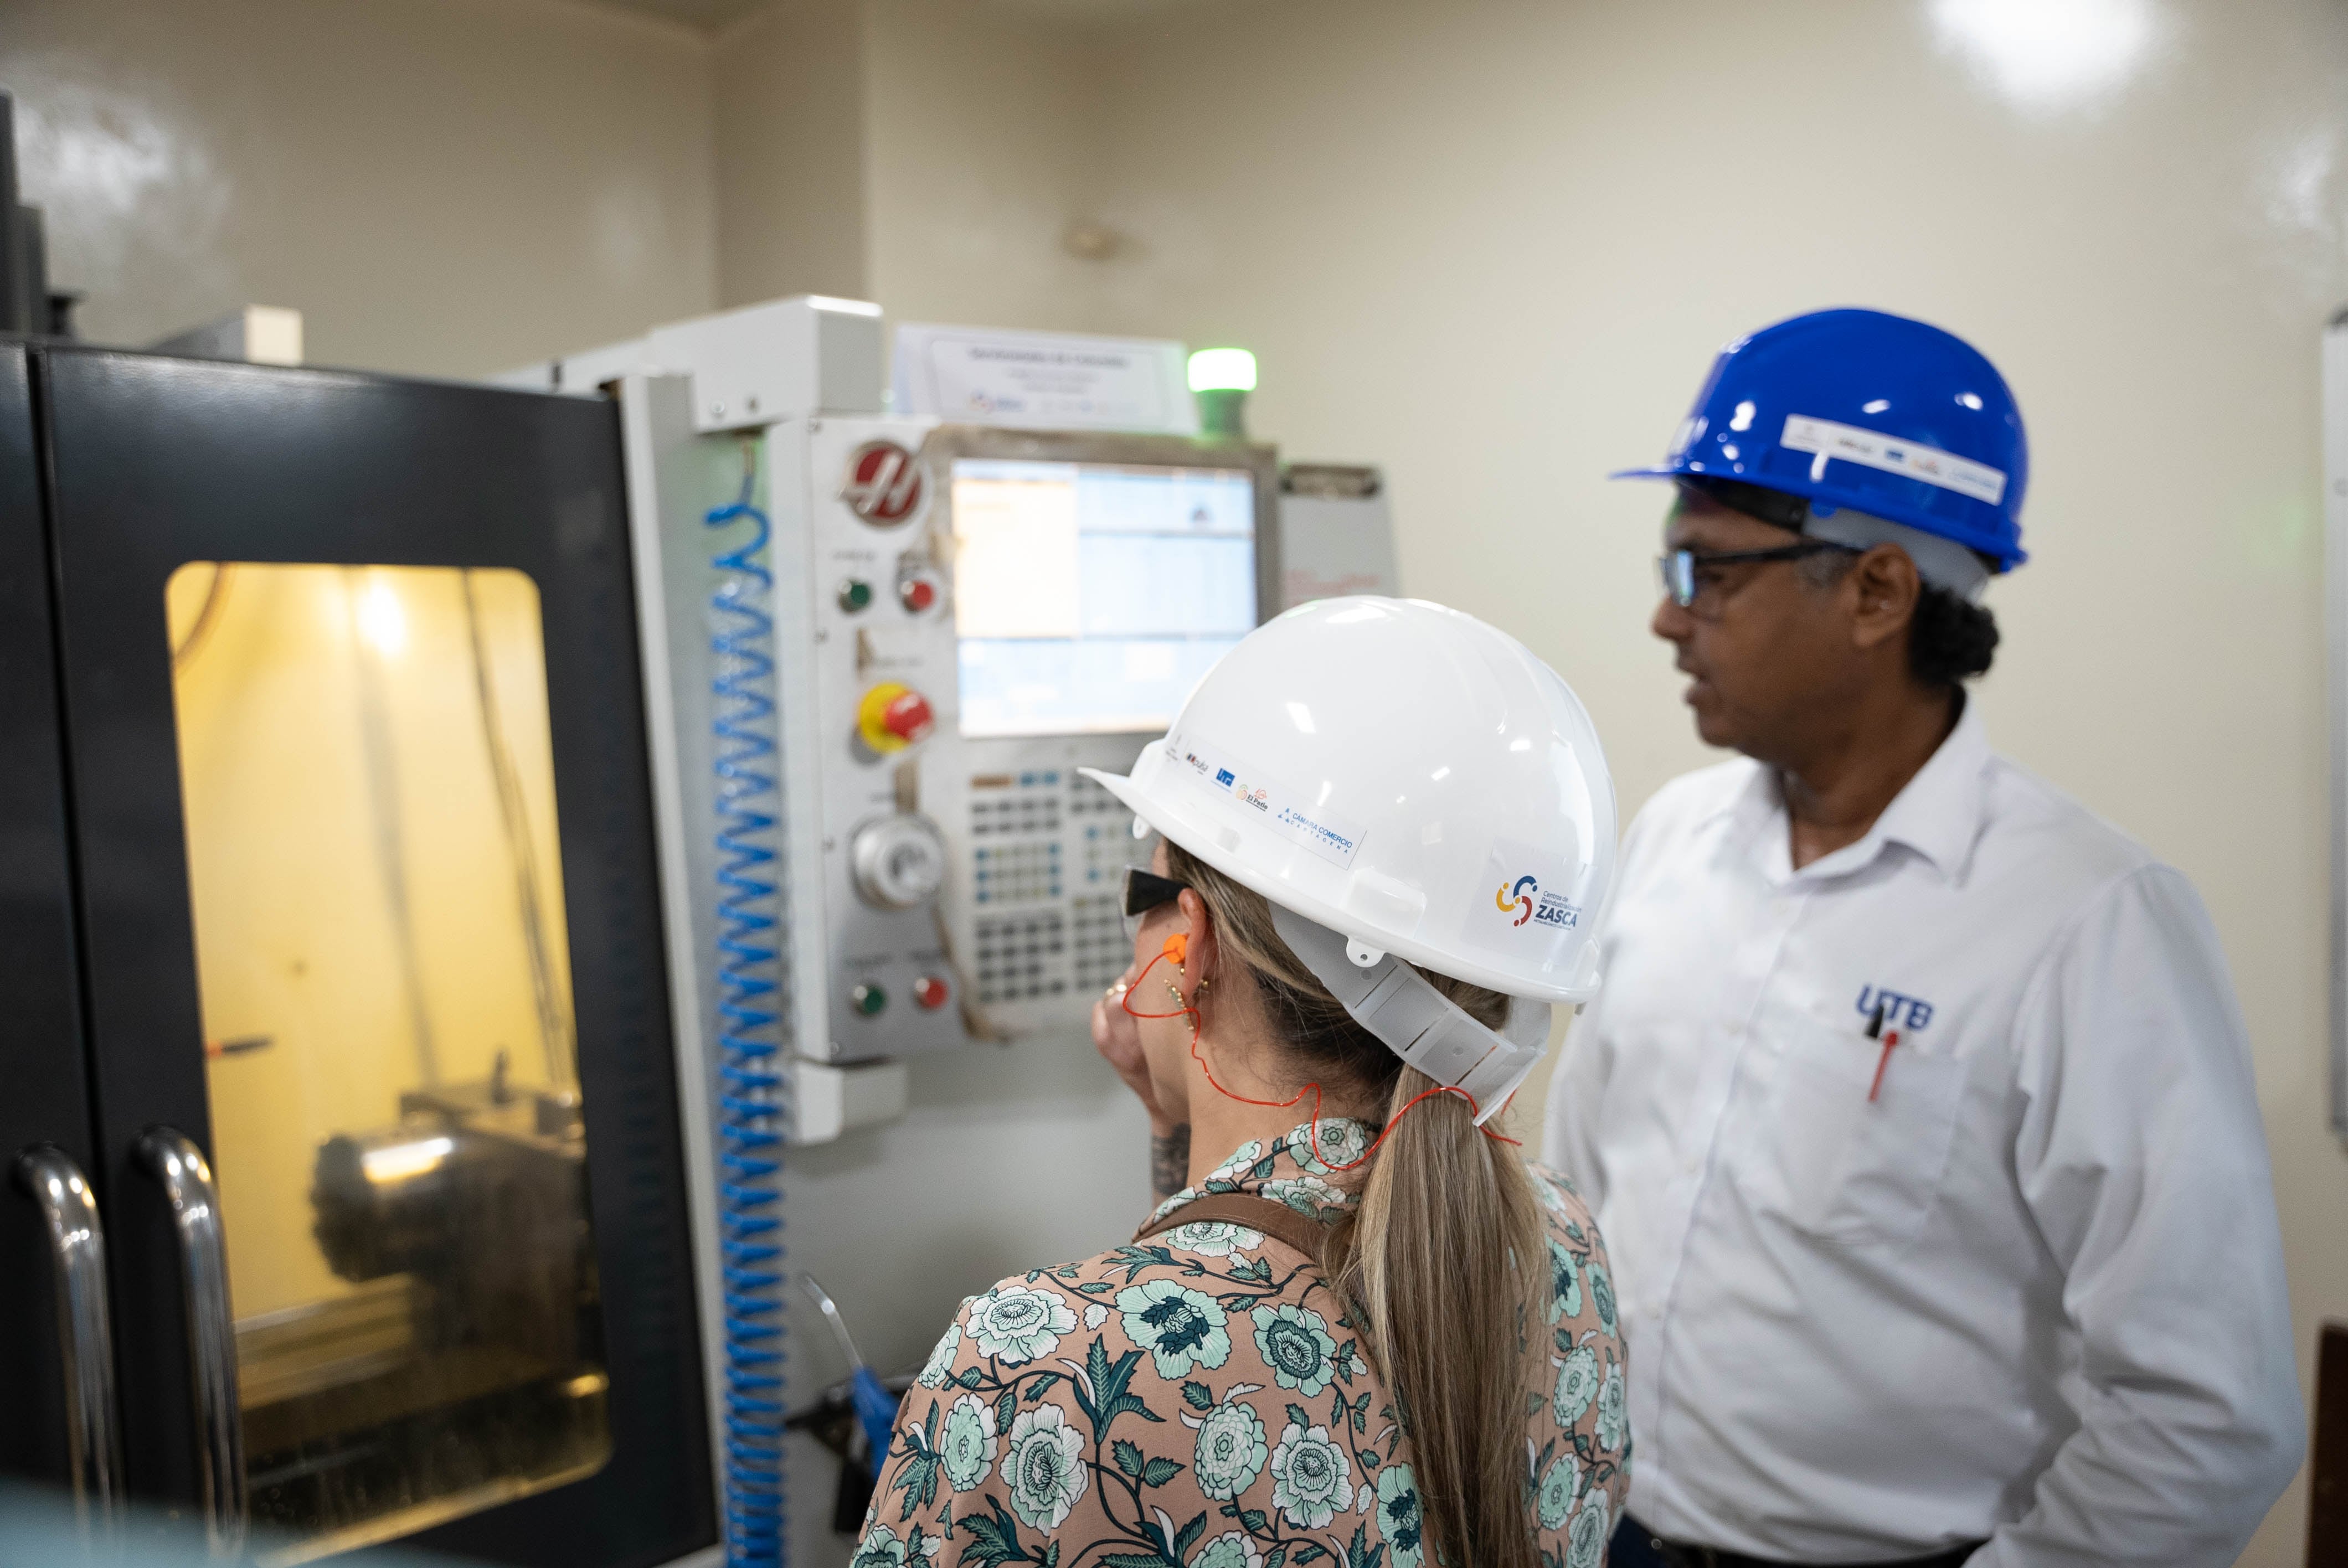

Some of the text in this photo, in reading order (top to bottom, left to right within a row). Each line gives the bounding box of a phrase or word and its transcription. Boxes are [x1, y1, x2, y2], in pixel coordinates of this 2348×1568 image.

[1253, 798, 1268, 809] Patio
[1319, 827, 1352, 848] COMERCIO
[1543, 890, 1562, 900] Centros
[1535, 904, 1577, 927] ZASCA
[1856, 984, 1933, 1030] UTB
